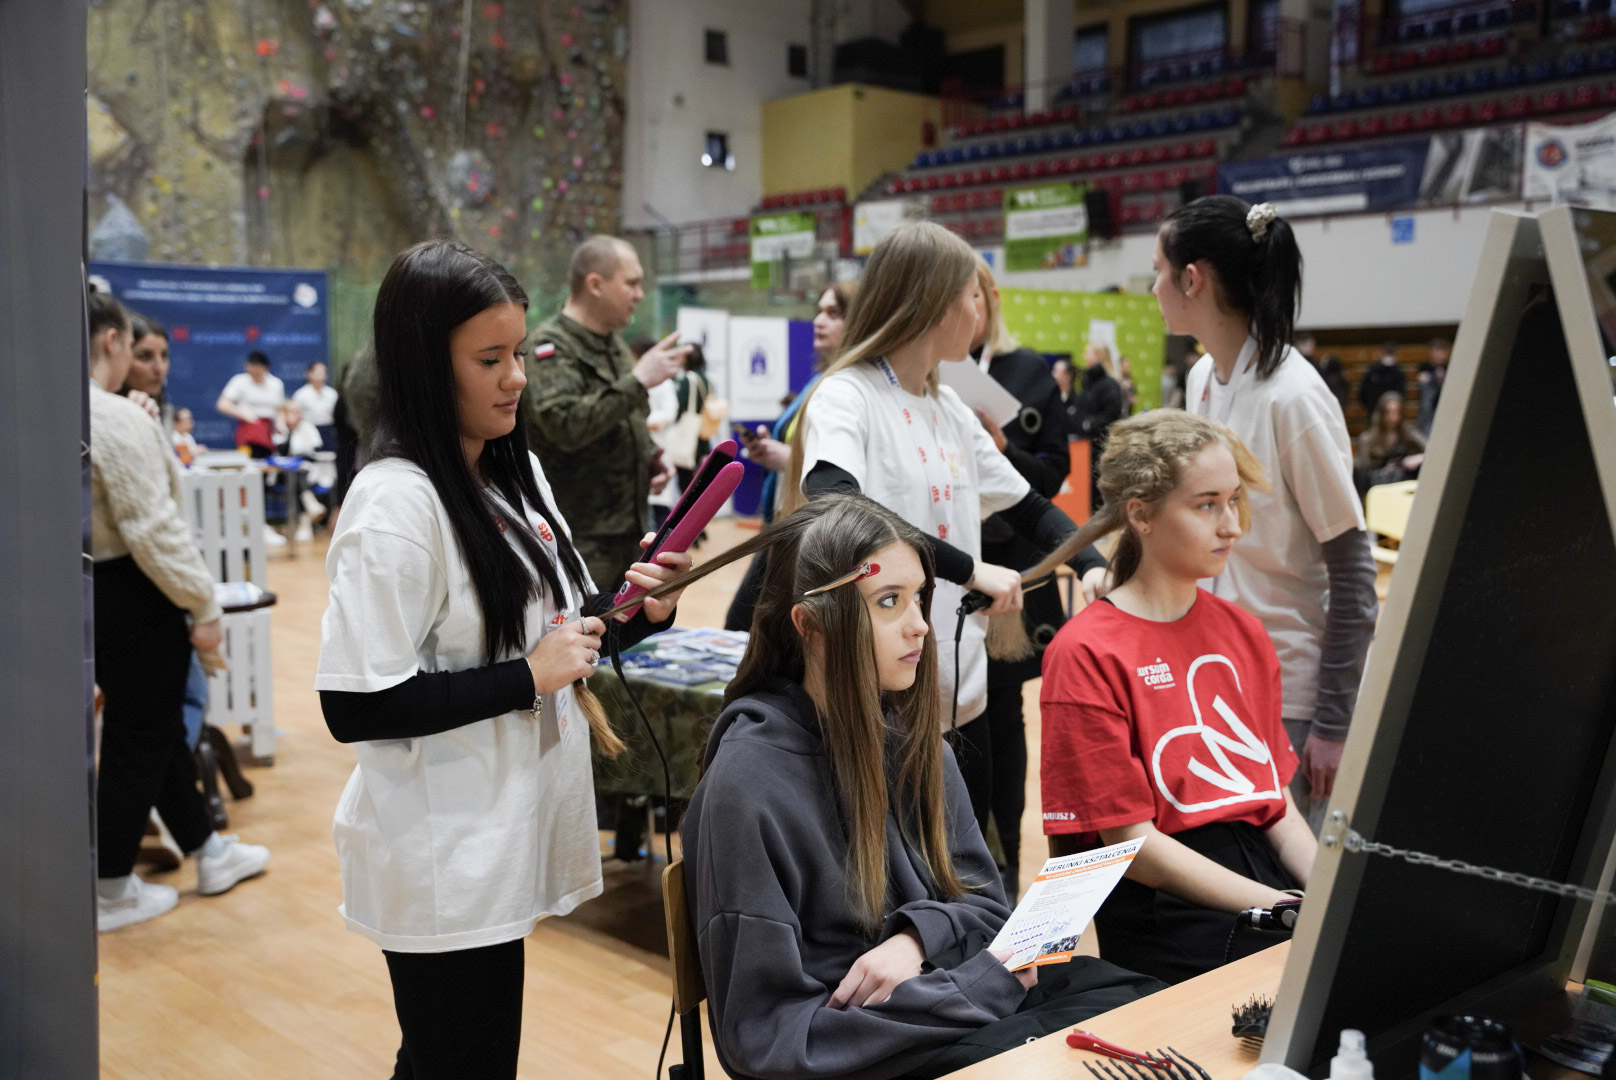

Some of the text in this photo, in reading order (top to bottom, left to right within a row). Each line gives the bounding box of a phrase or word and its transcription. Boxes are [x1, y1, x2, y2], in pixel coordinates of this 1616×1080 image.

[931, 485, 940, 503] dts
[537, 522, 553, 542] dts
[1144, 672, 1174, 686] corda
[1043, 860, 1083, 873] KIERUNKI
[1083, 846, 1137, 865] KSZTAŁCENIA
